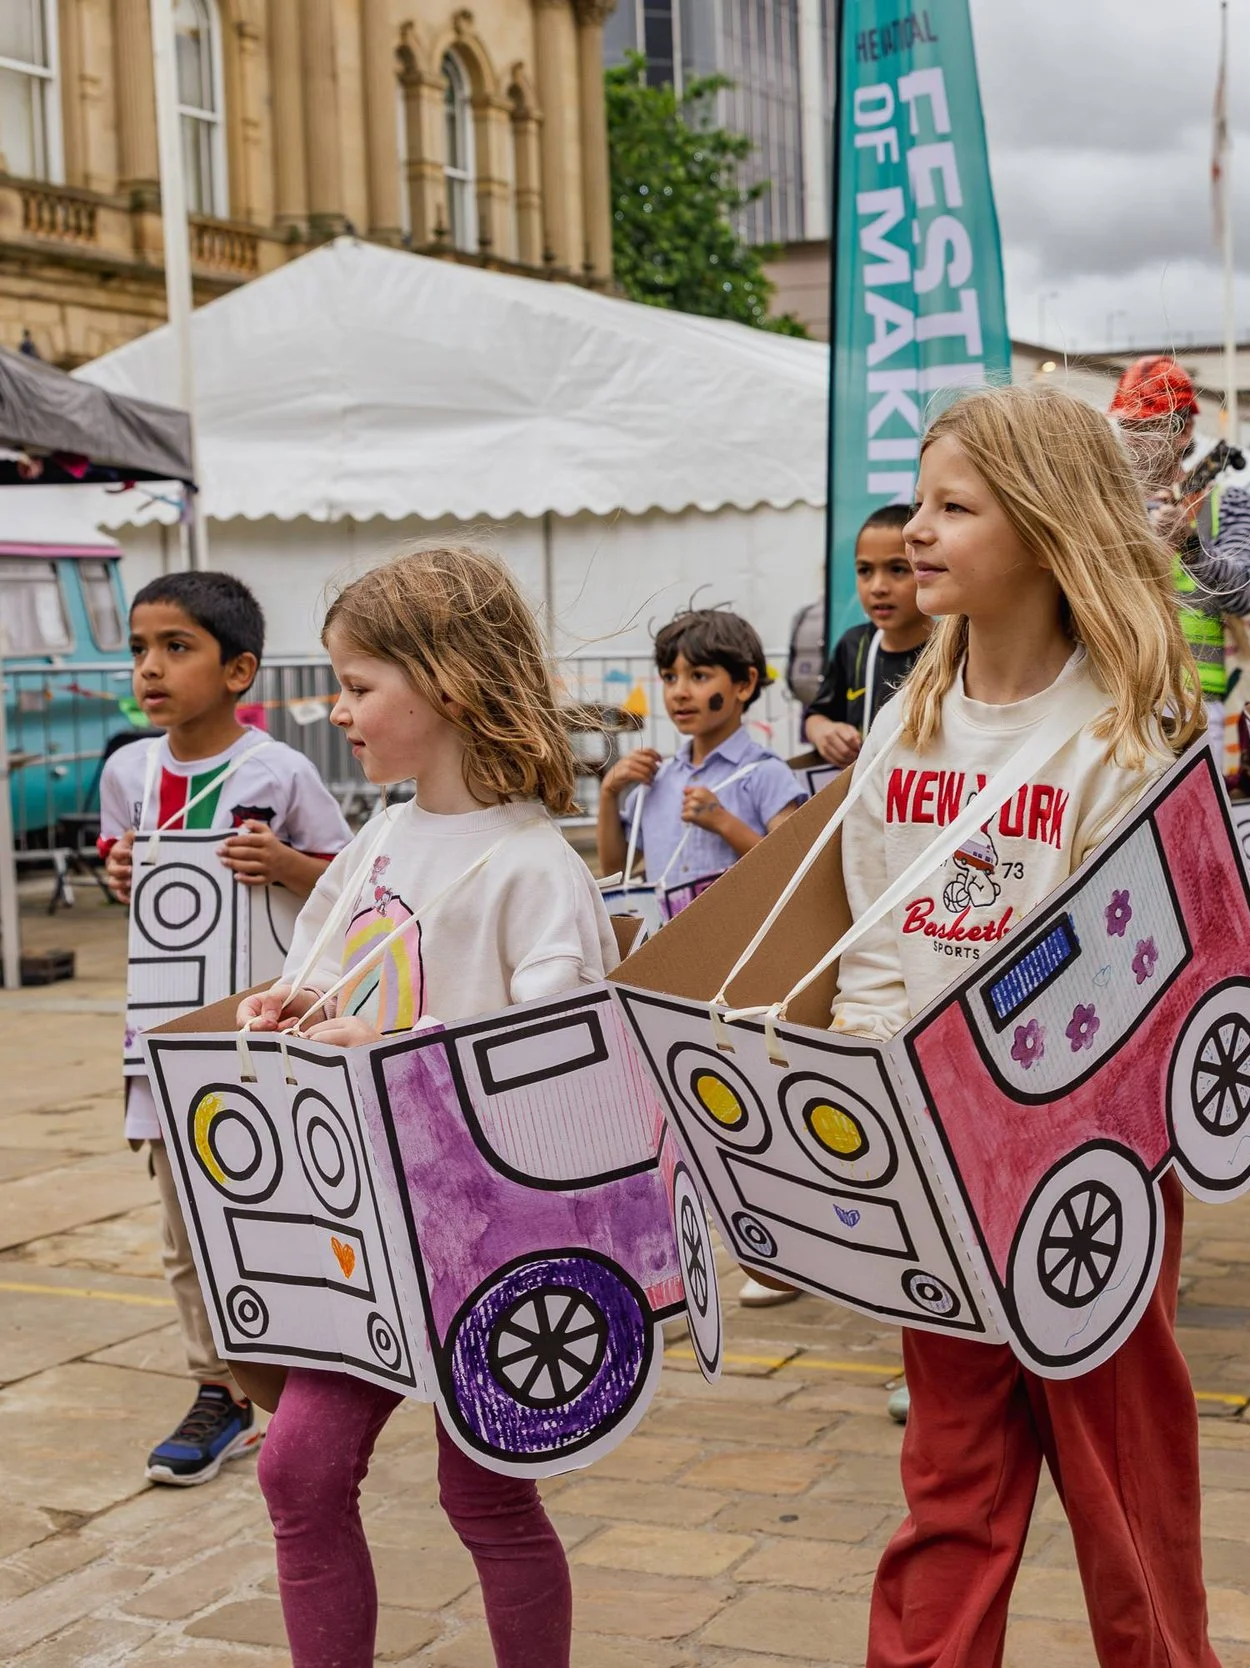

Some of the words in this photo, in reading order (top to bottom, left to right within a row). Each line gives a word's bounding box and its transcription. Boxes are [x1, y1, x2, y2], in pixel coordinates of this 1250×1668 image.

[854, 81, 900, 164] OF
[886, 768, 965, 827] NEW
[977, 774, 1071, 850] ORK
[1001, 862, 1024, 880] 73
[932, 940, 981, 960] SPORTS
